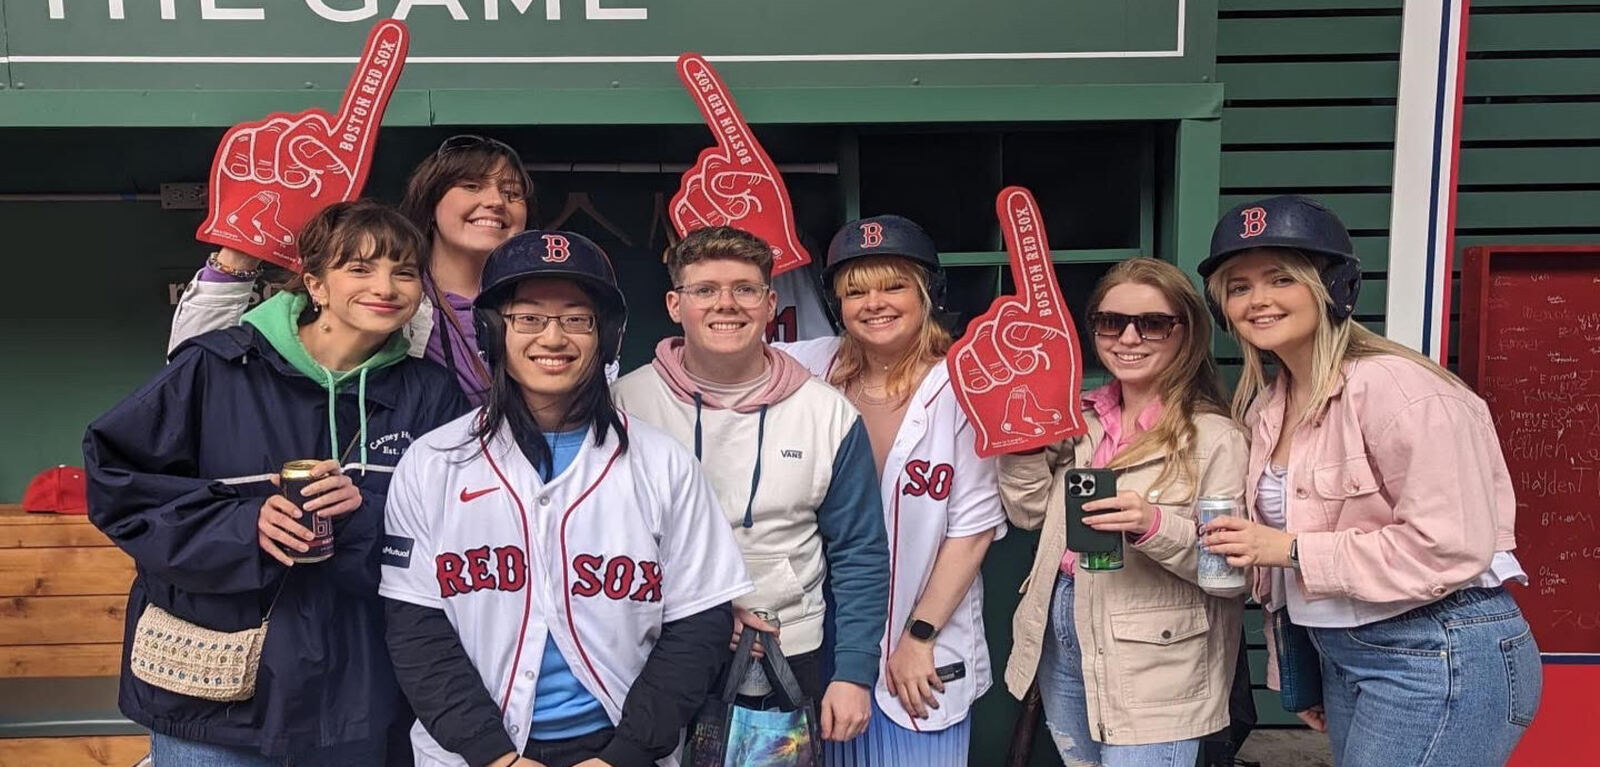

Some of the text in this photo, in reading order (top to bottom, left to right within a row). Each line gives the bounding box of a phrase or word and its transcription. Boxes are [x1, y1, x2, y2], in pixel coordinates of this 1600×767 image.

[339, 40, 397, 152] BOSTON RED SOX
[693, 70, 752, 165] BOSTON RED SOX
[860, 222, 883, 248] B
[1240, 207, 1267, 239] B
[541, 234, 570, 262] B
[1016, 206, 1052, 317] BOSTON RED SOX
[370, 433, 399, 450] Carney
[780, 450, 803, 459] VANS
[903, 459, 954, 501] SO
[435, 545, 663, 602] RED SOX
